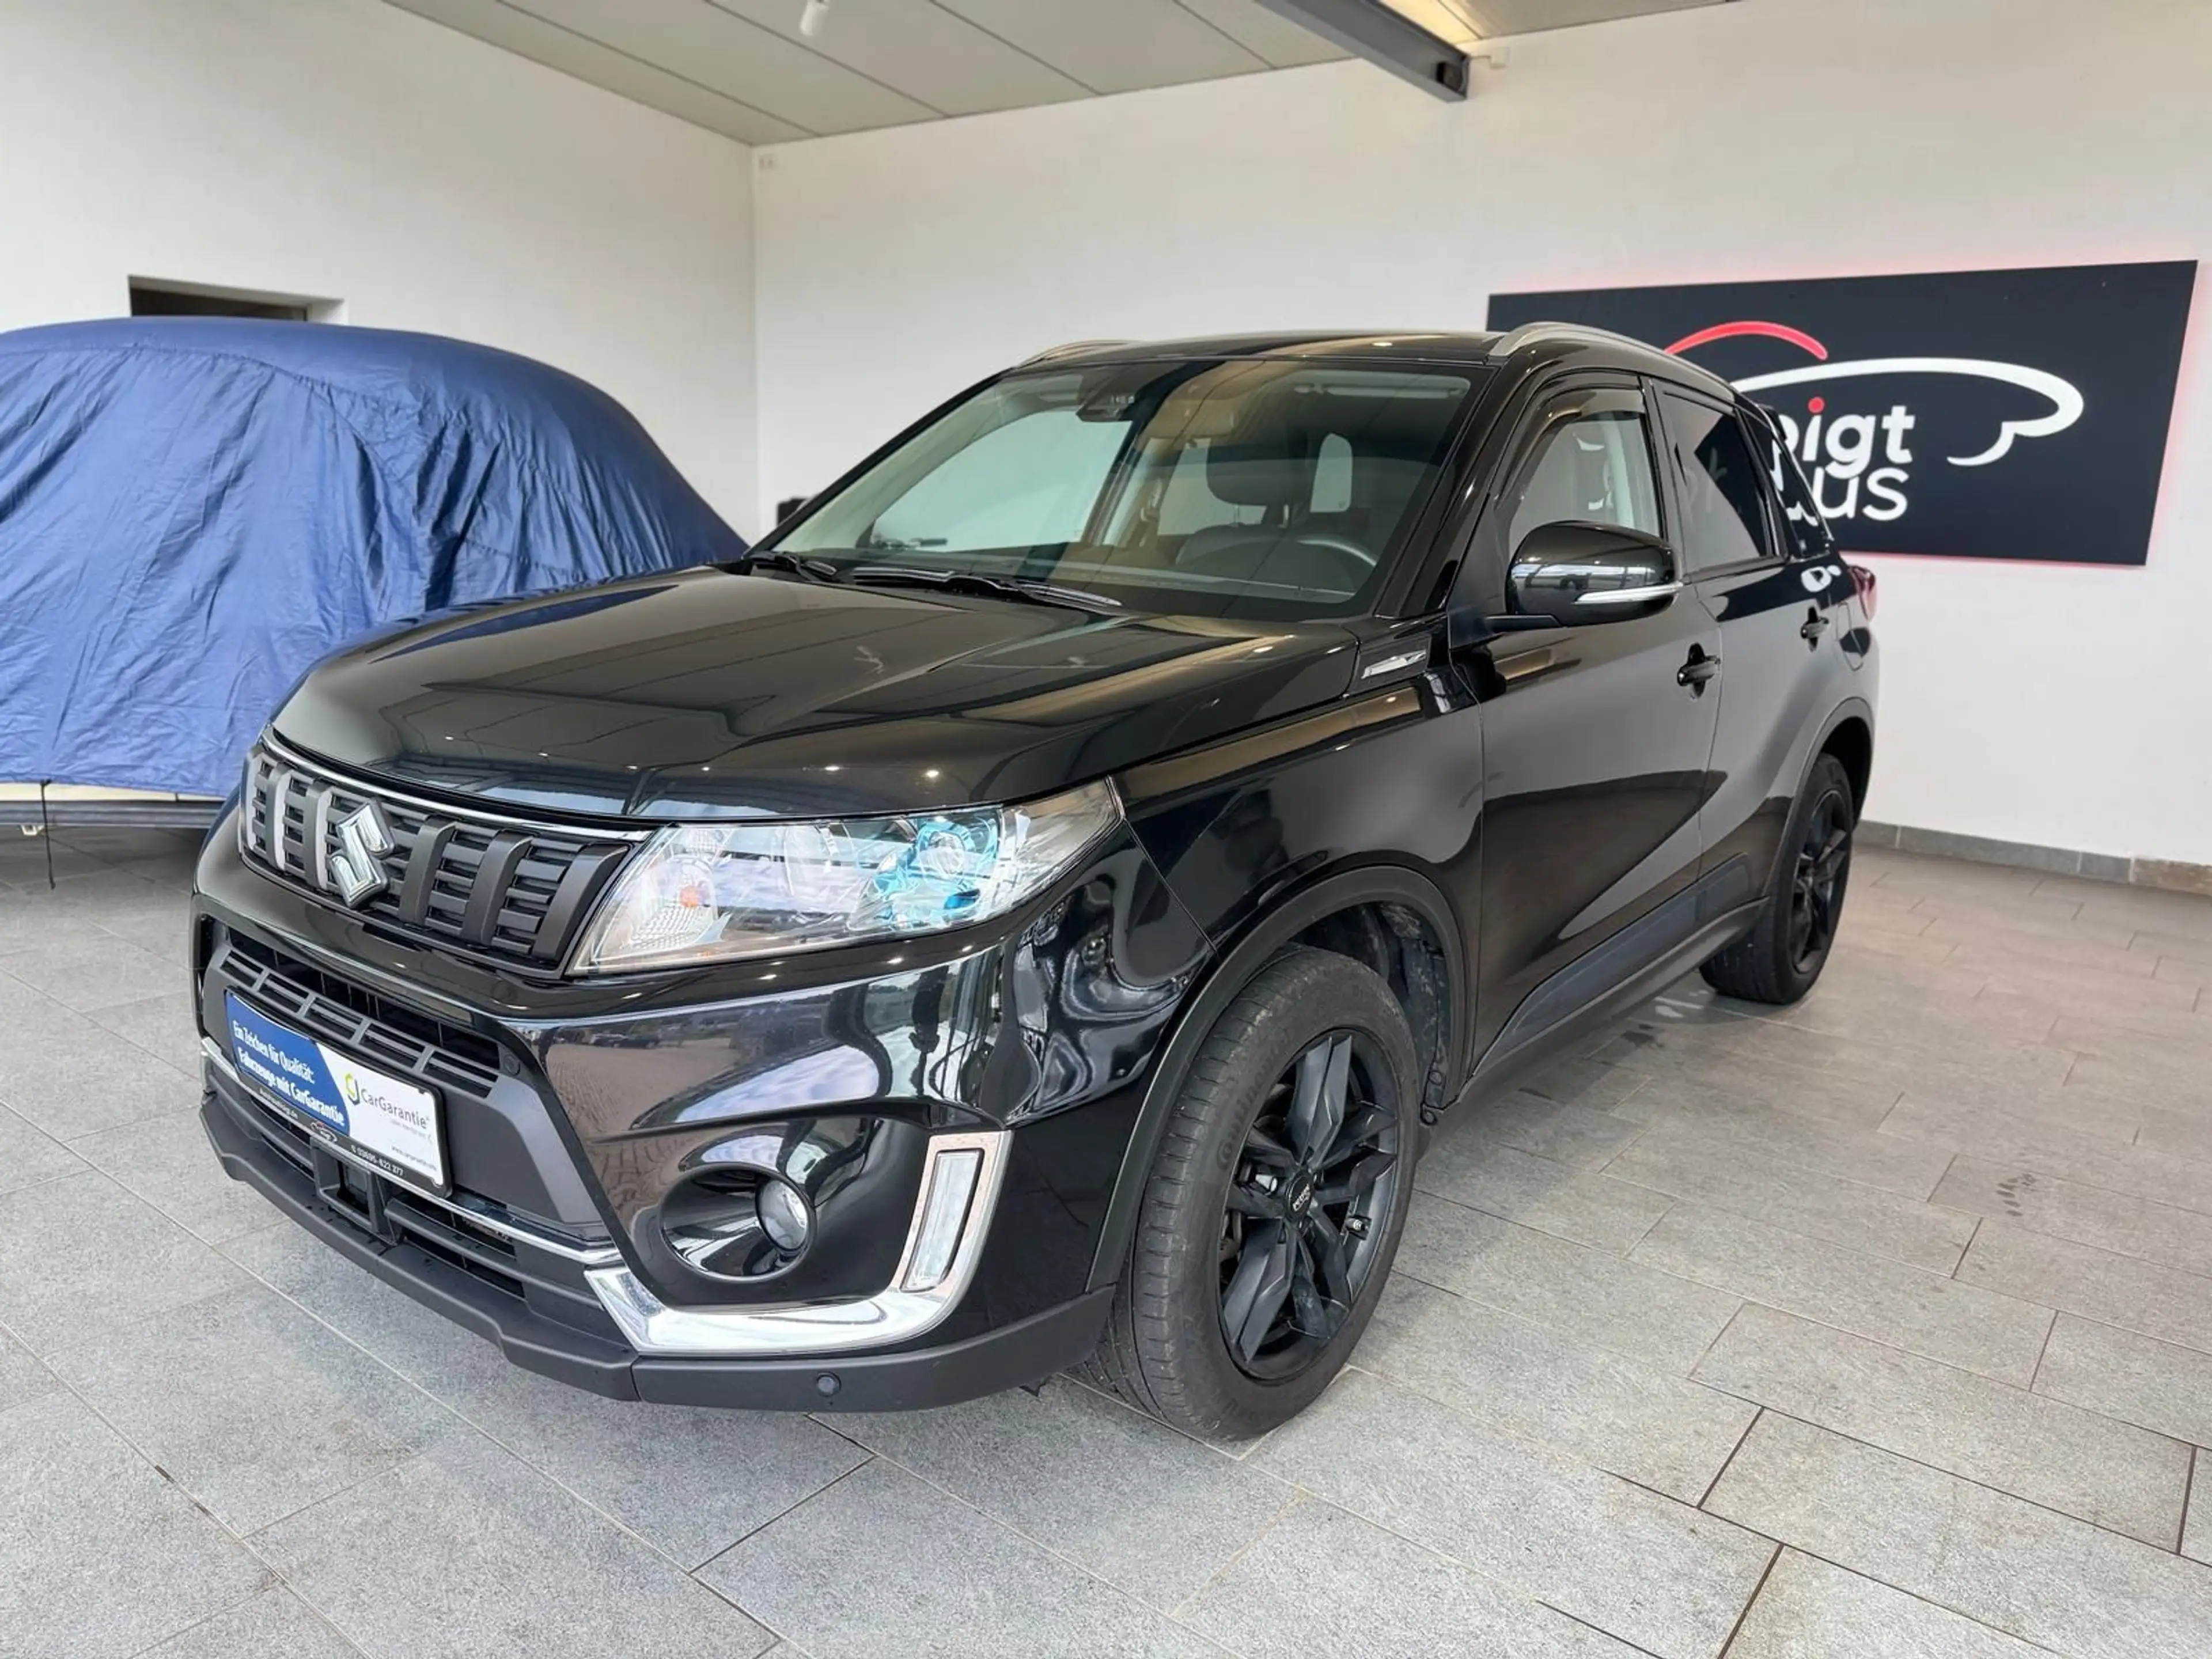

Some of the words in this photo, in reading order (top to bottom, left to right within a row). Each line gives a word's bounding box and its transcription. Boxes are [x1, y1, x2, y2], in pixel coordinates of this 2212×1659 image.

[232, 1020, 245, 1041] Ein
[244, 1028, 269, 1058] Zeichen
[238, 1046, 276, 1088] Fahrzeuge
[275, 1075, 291, 1096] mit
